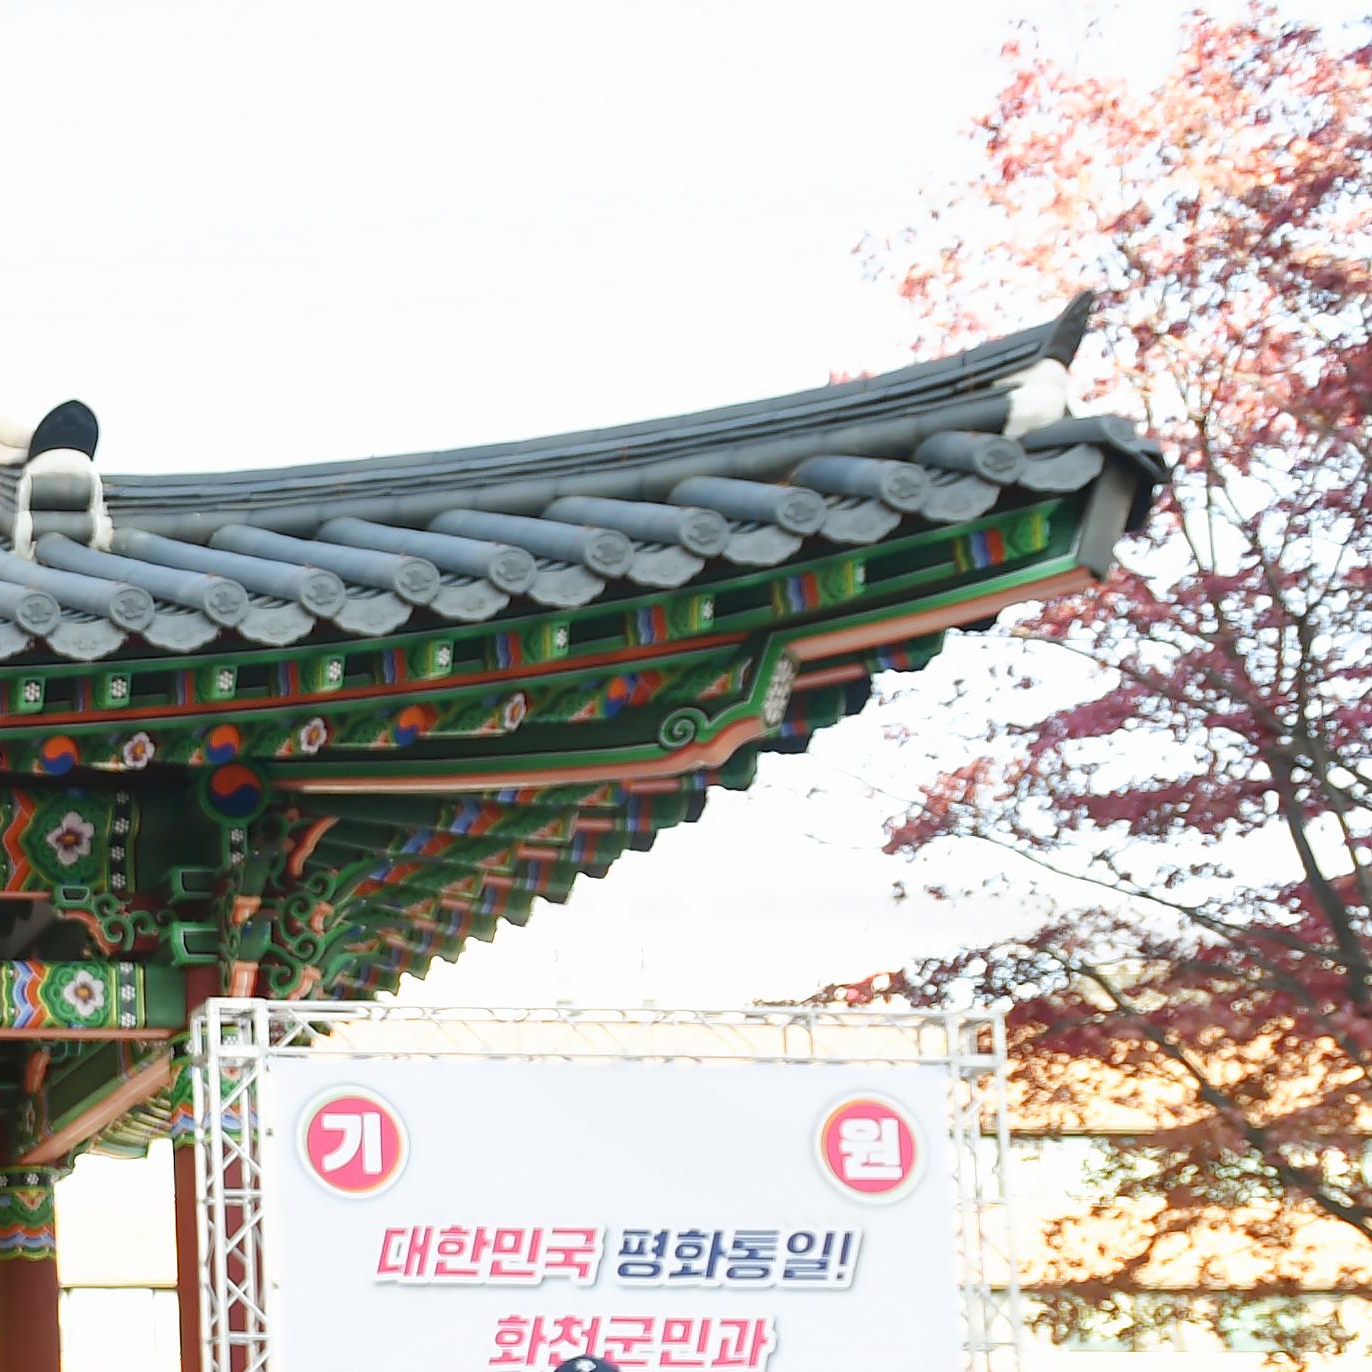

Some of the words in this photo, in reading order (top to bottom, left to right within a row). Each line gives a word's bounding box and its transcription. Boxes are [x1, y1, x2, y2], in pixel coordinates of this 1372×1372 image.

[321, 1111, 383, 1175] 기
[839, 1117, 903, 1179] 원
[376, 1225, 597, 1280] 대한민국
[616, 1227, 852, 1281] 평화통일!
[488, 1314, 769, 1367] 화천군민과
